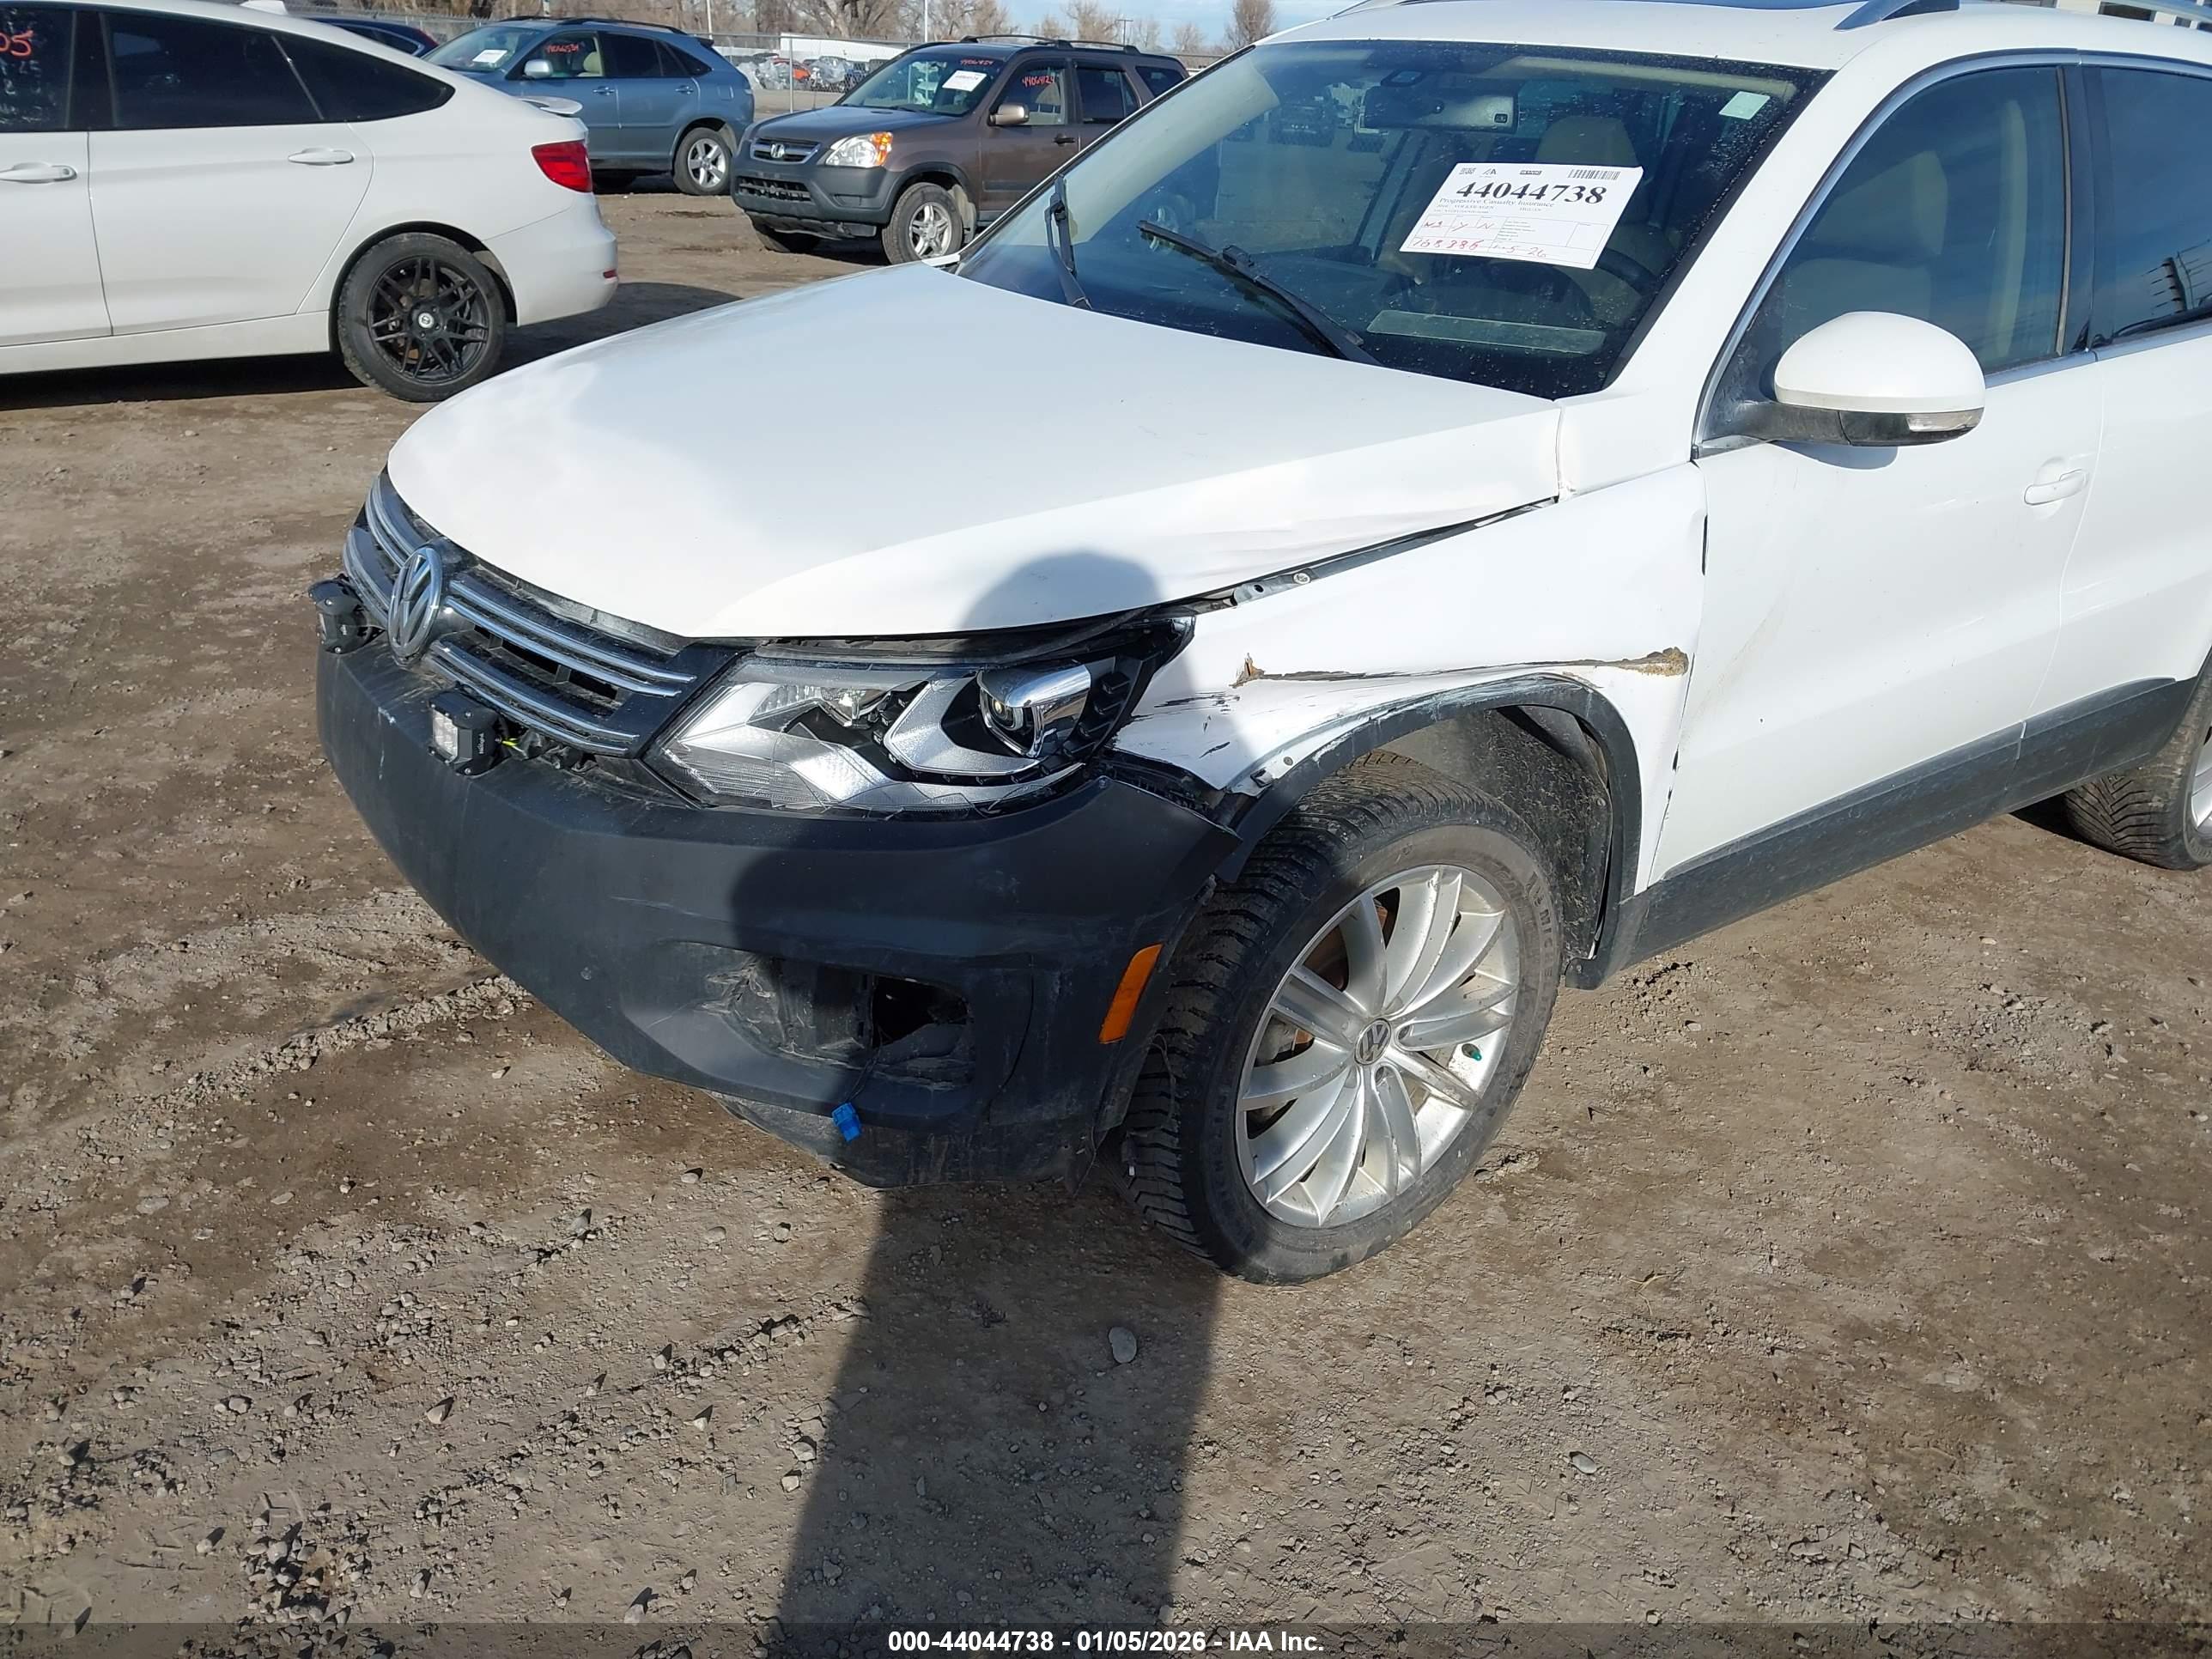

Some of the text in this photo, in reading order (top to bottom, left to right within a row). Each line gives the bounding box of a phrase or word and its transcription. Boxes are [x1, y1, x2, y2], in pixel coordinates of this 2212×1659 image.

[1456, 181, 1607, 204] 44044738
[1438, 198, 1481, 206] Progressive
[1483, 198, 1516, 207] Casualty
